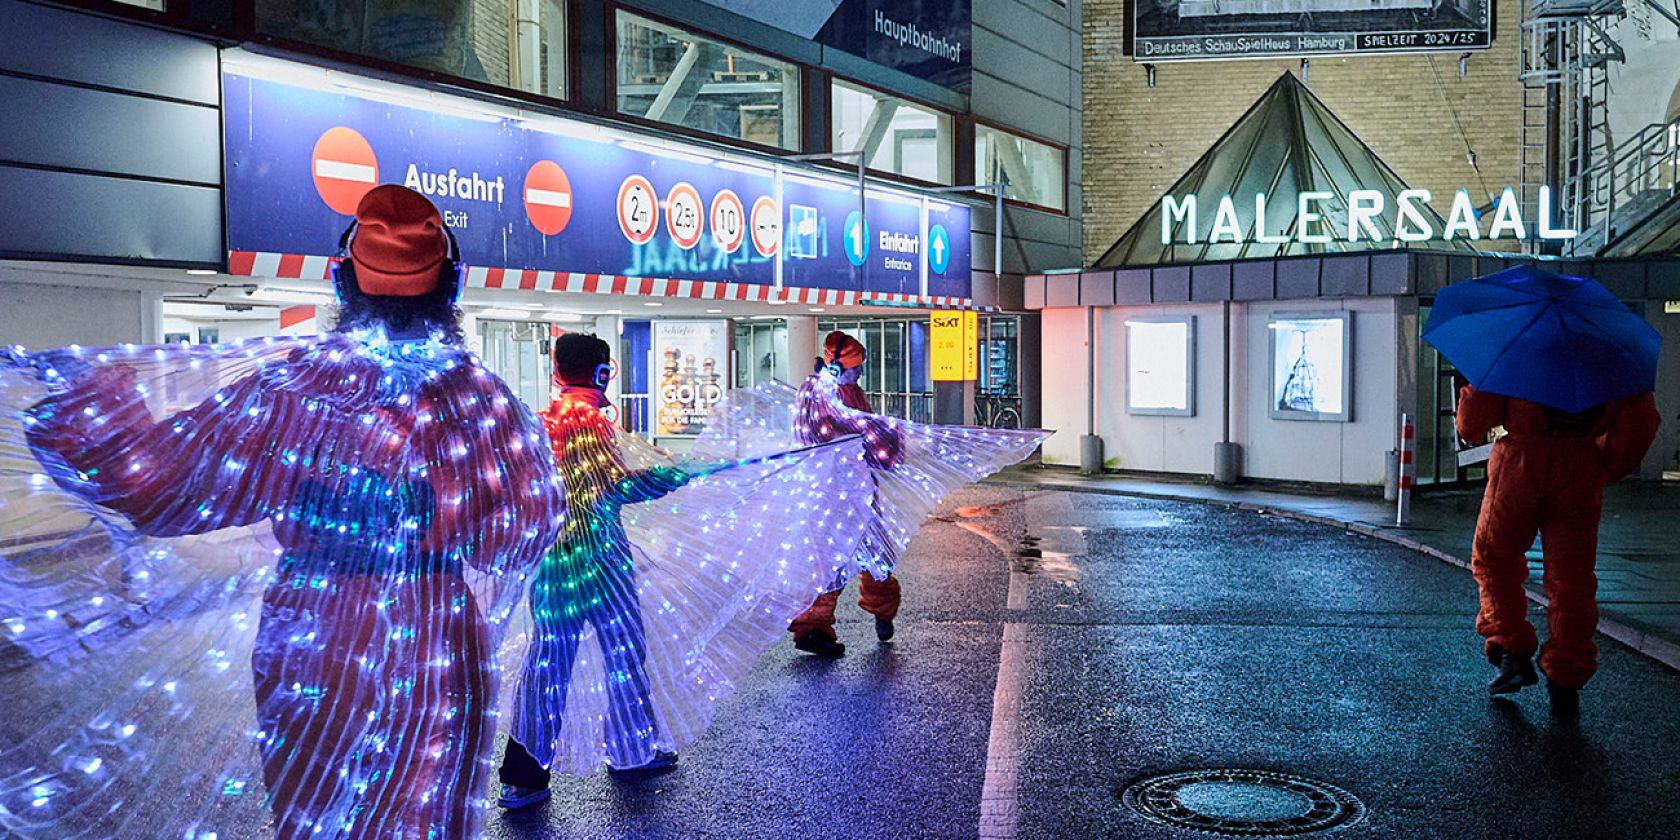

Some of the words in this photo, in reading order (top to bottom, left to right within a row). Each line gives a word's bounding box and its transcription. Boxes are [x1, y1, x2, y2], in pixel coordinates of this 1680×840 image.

[875, 9, 961, 62] Hauptbahnhof
[1144, 41, 1201, 55] Deutsches
[1298, 36, 1345, 49] Hamburg
[1364, 35, 1417, 47] SPIELZEIT
[1424, 33, 1476, 45] 2024/25
[404, 163, 505, 204] Ausfahrt
[444, 210, 469, 229] Exit
[720, 209, 735, 235] 10
[1161, 185, 1578, 245] MALERSAAL
[880, 230, 919, 254] Einfahrt
[884, 257, 913, 271] Entrance
[662, 384, 722, 404] GOLD
